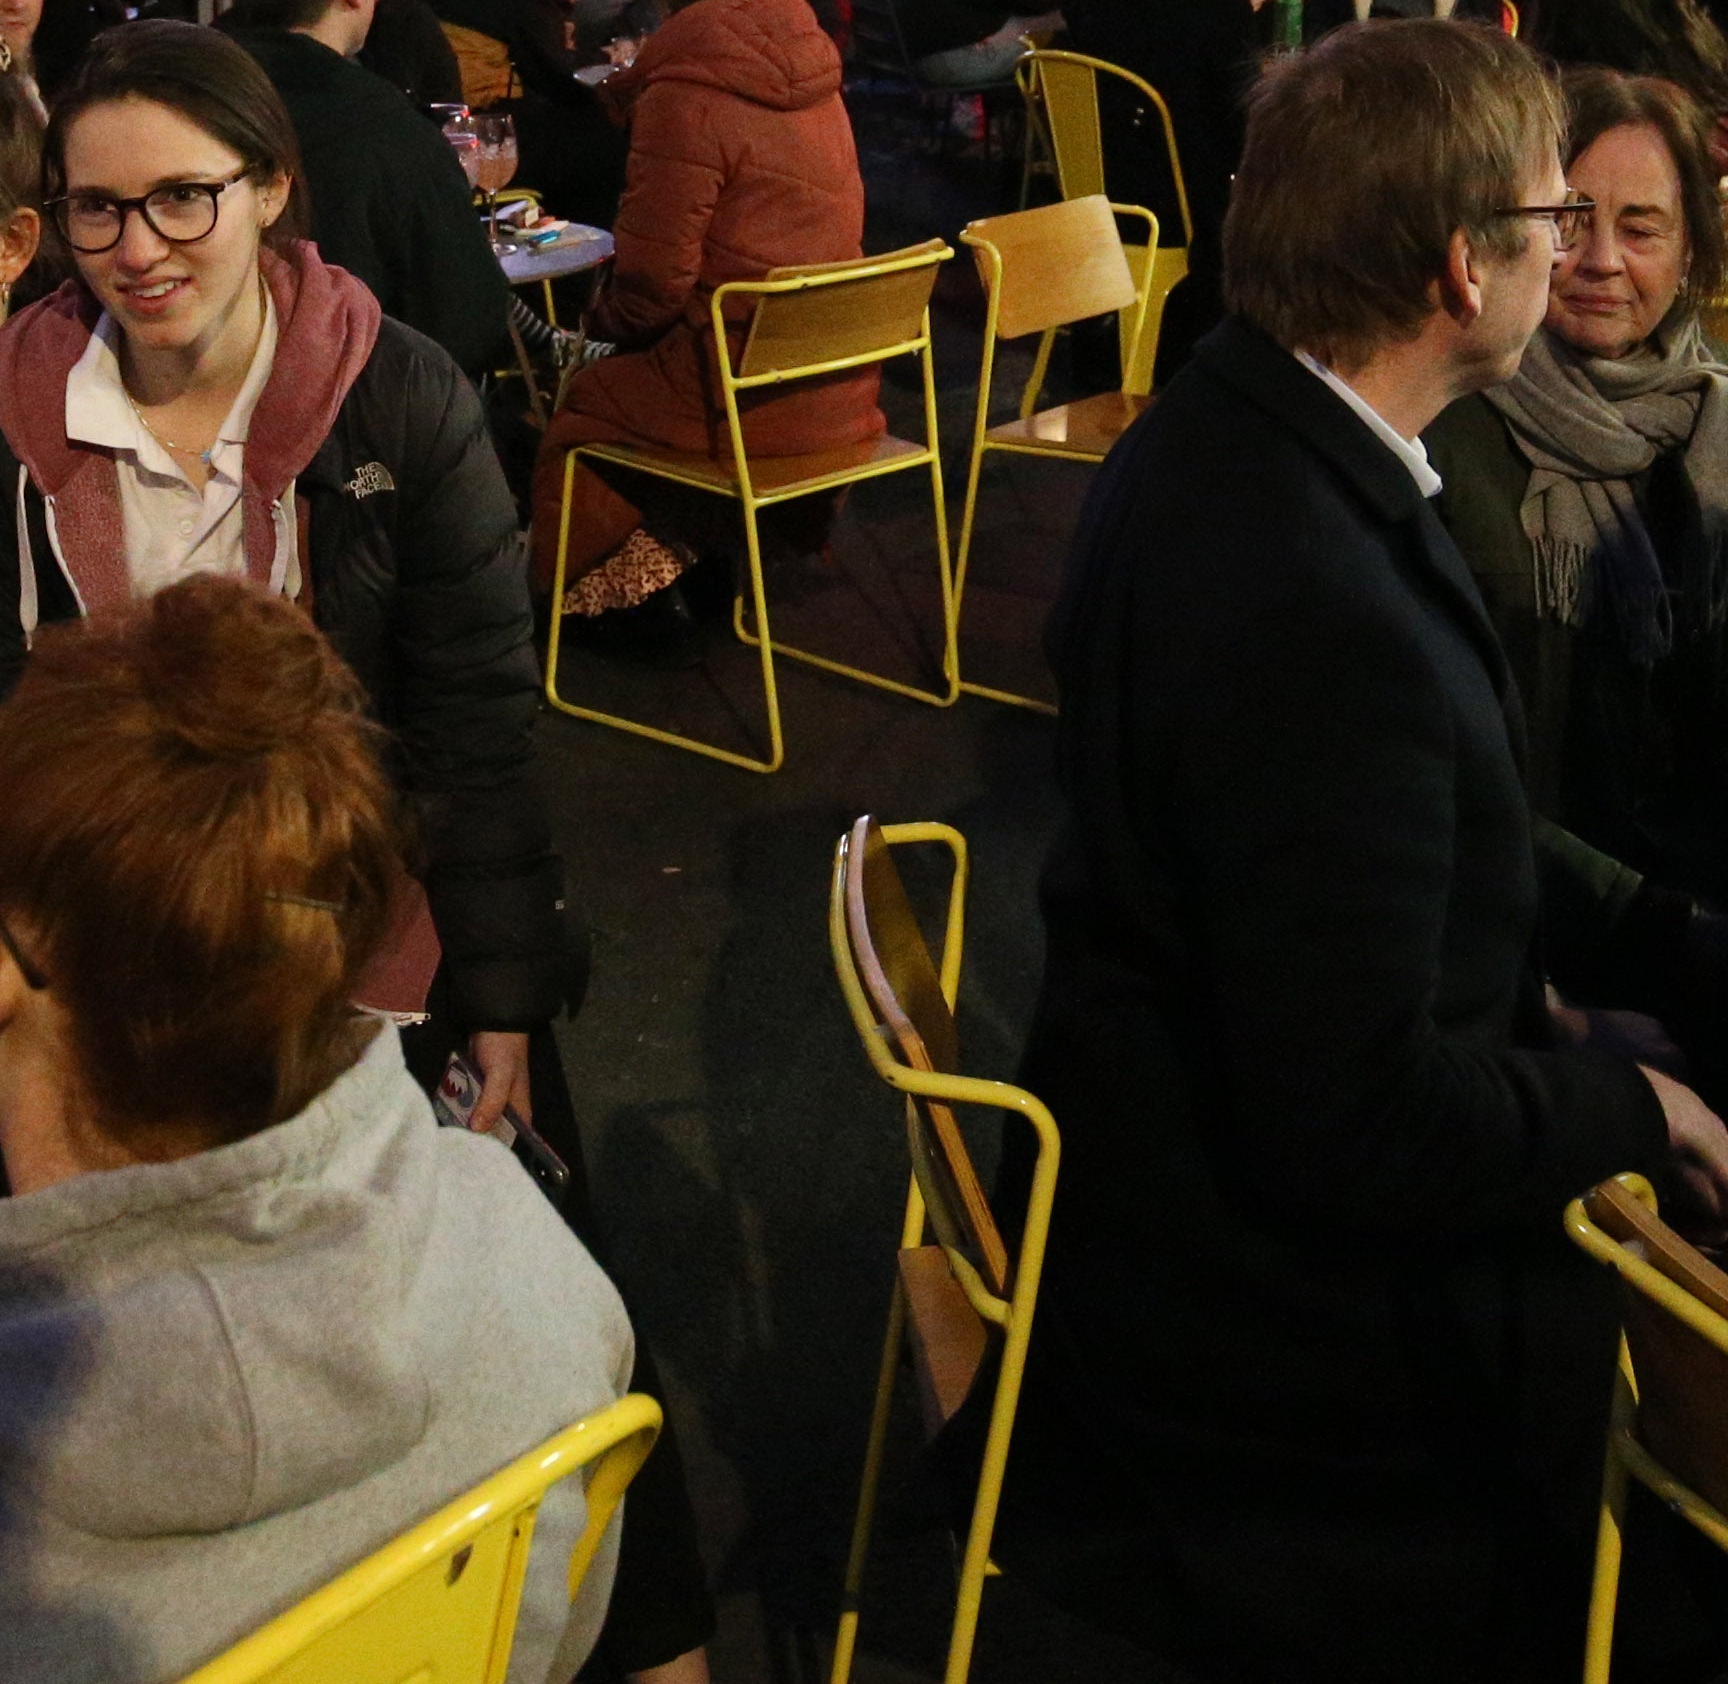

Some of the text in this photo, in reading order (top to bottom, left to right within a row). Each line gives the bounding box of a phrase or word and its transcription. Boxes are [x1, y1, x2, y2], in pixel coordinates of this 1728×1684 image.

[355, 463, 377, 478] THE
[344, 473, 379, 491] NORTH
[355, 483, 381, 499] FACE
